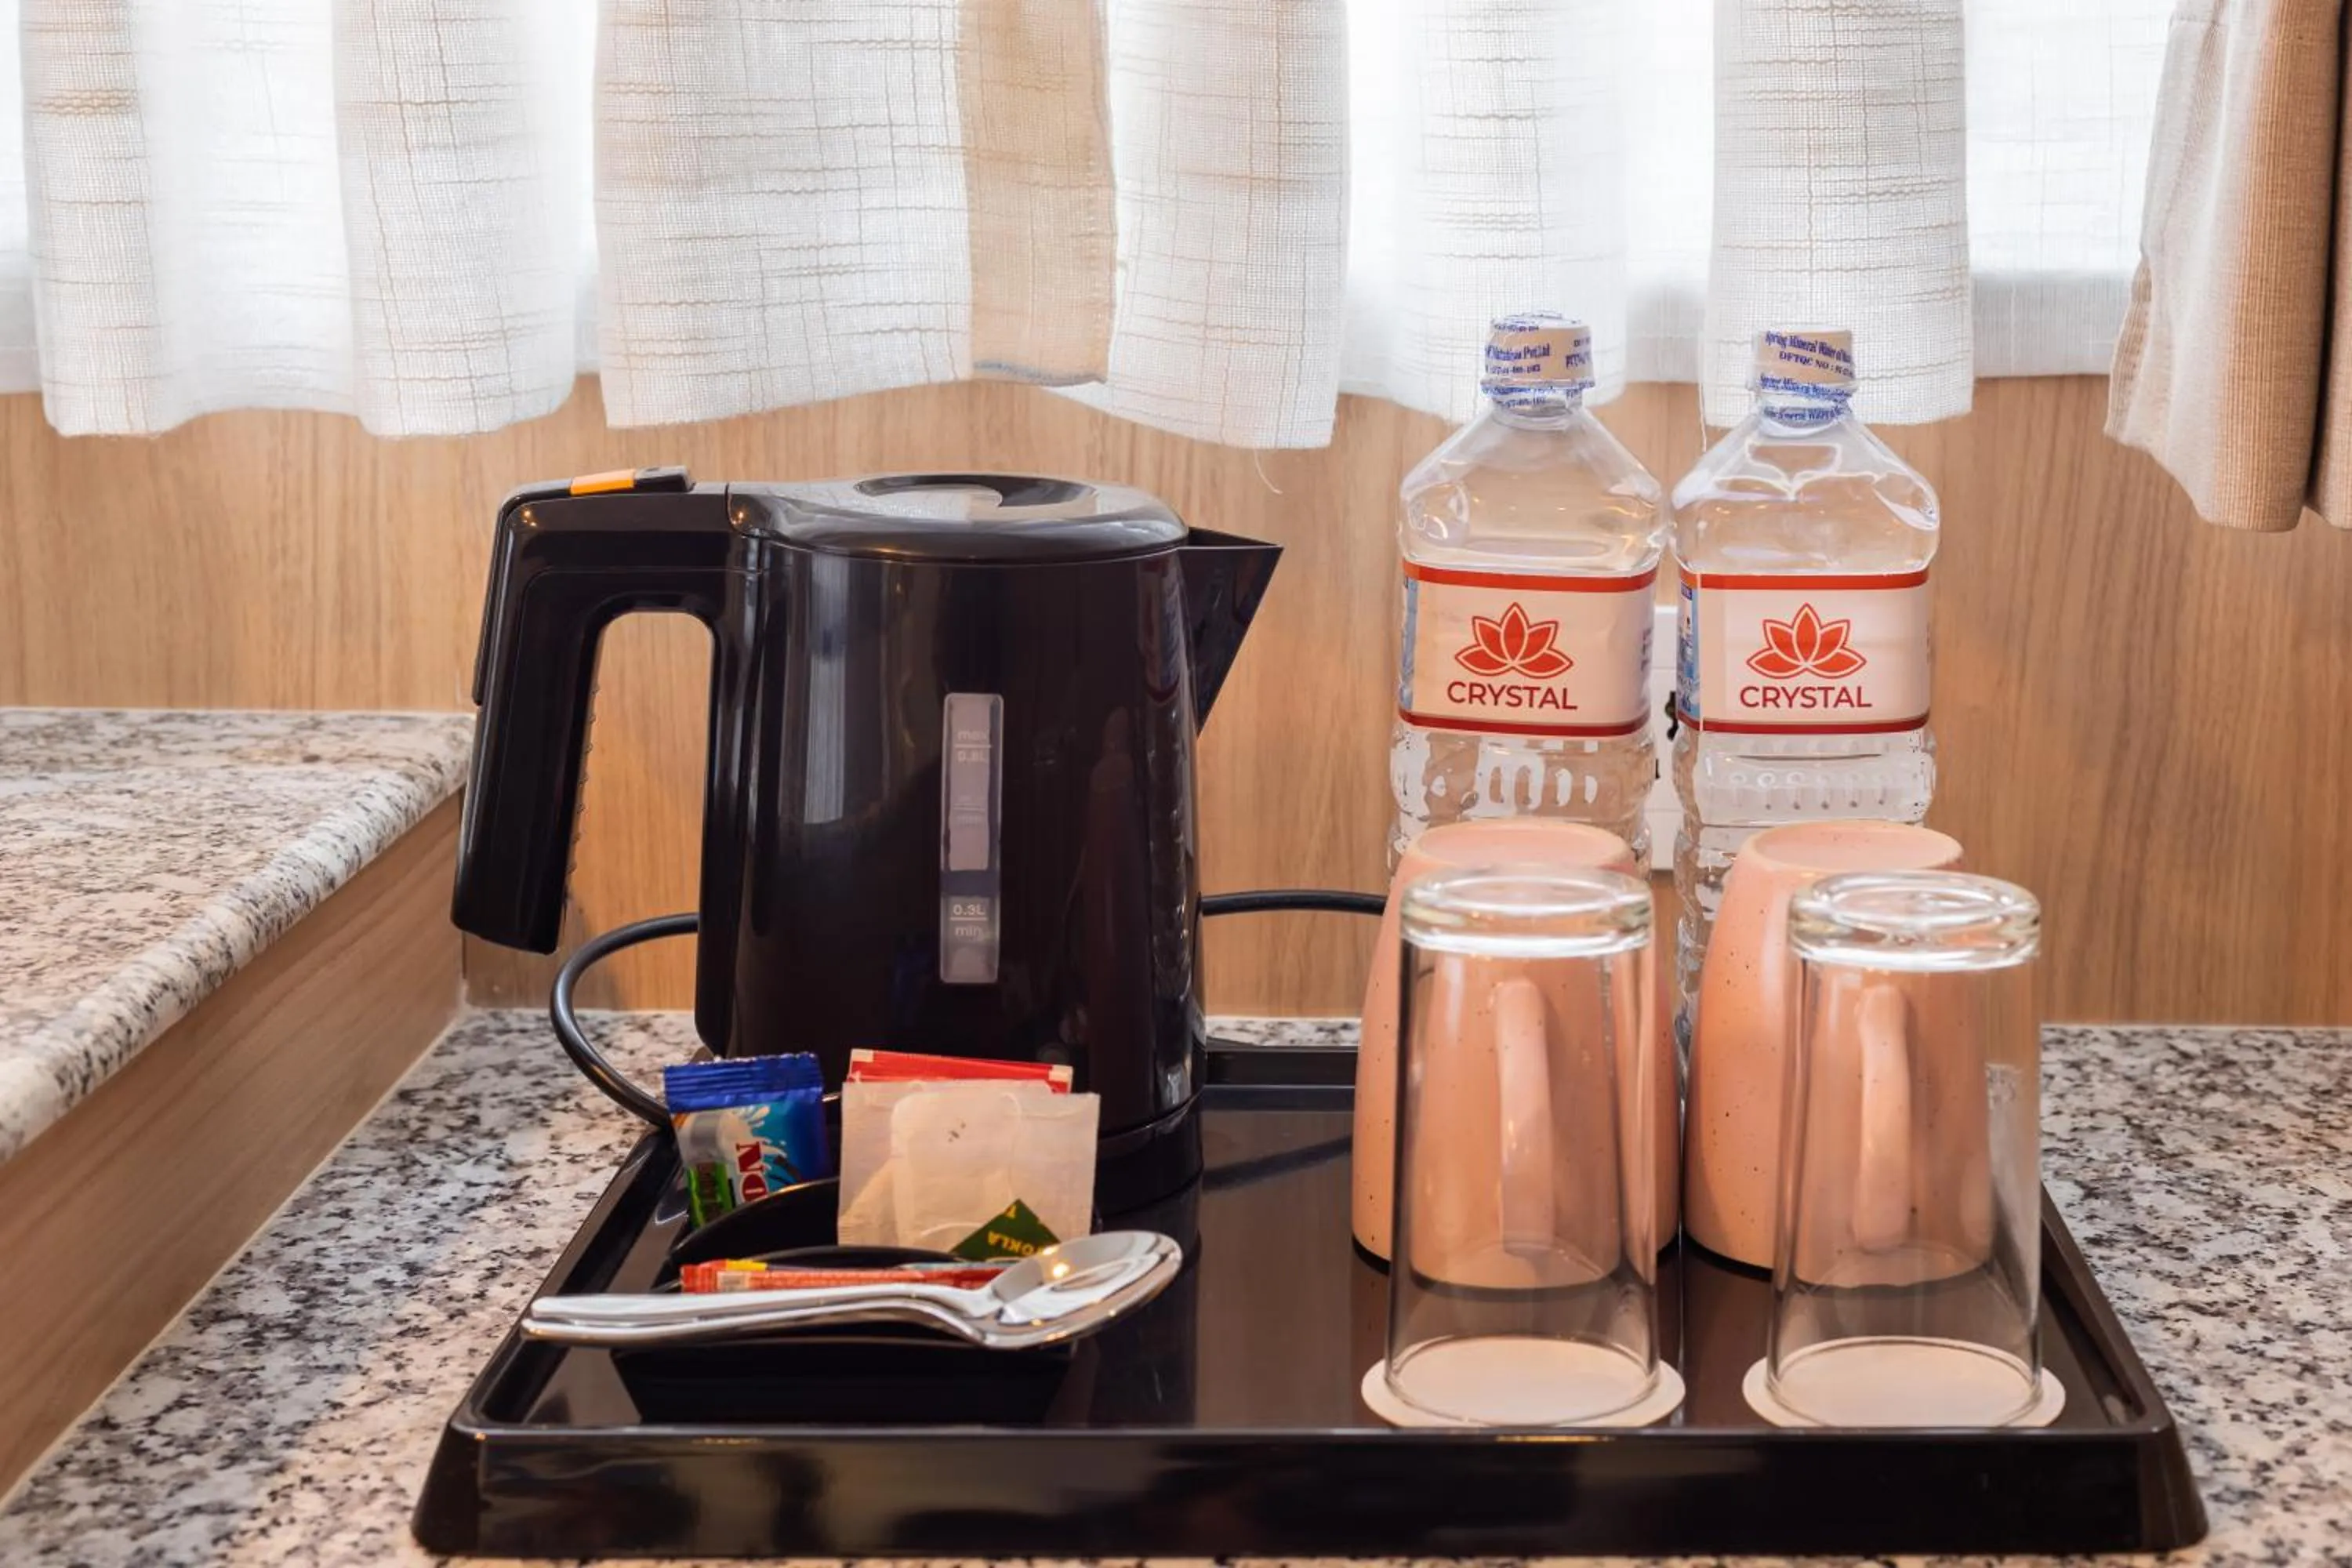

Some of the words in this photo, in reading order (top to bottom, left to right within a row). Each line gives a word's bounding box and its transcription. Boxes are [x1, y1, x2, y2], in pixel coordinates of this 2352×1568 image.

[1447, 681, 1578, 710] CRYSTAL
[1740, 685, 1873, 709] CRYSTAL
[953, 903, 985, 916] 0.3L
[955, 924, 983, 938] min
